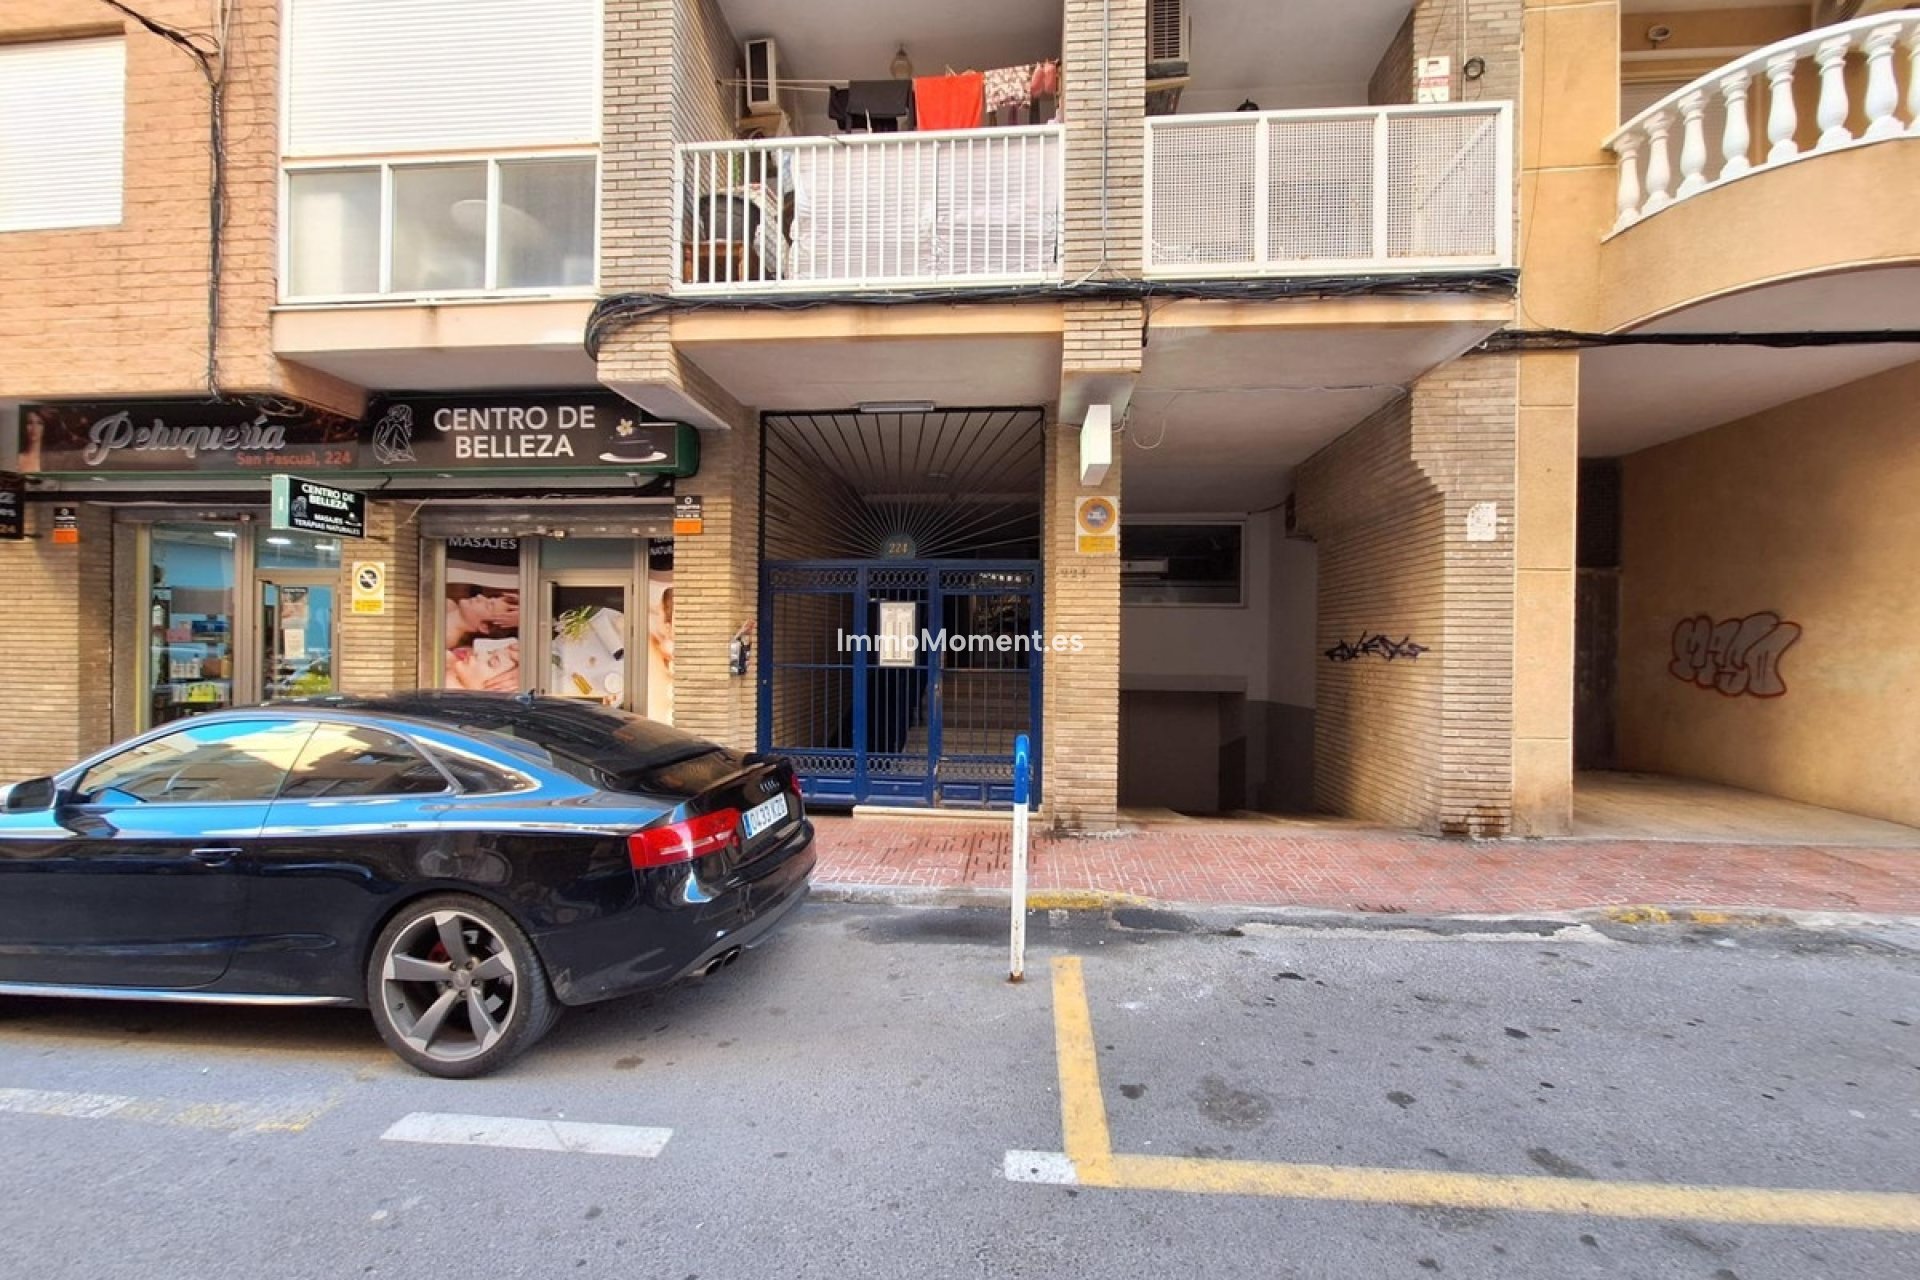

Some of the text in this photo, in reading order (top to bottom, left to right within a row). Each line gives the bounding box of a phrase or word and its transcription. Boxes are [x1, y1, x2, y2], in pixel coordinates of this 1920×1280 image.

[433, 405, 596, 431] CENTRO DE
[84, 411, 286, 466] Peluquería
[455, 434, 574, 458] BELLEZA
[236, 453, 261, 465] San
[266, 451, 320, 467] Pascual,
[301, 483, 355, 503] CENTRO DE
[308, 494, 349, 510] BELLEZA
[314, 513, 343, 525] MASAJES
[448, 536, 517, 549] MASAJES
